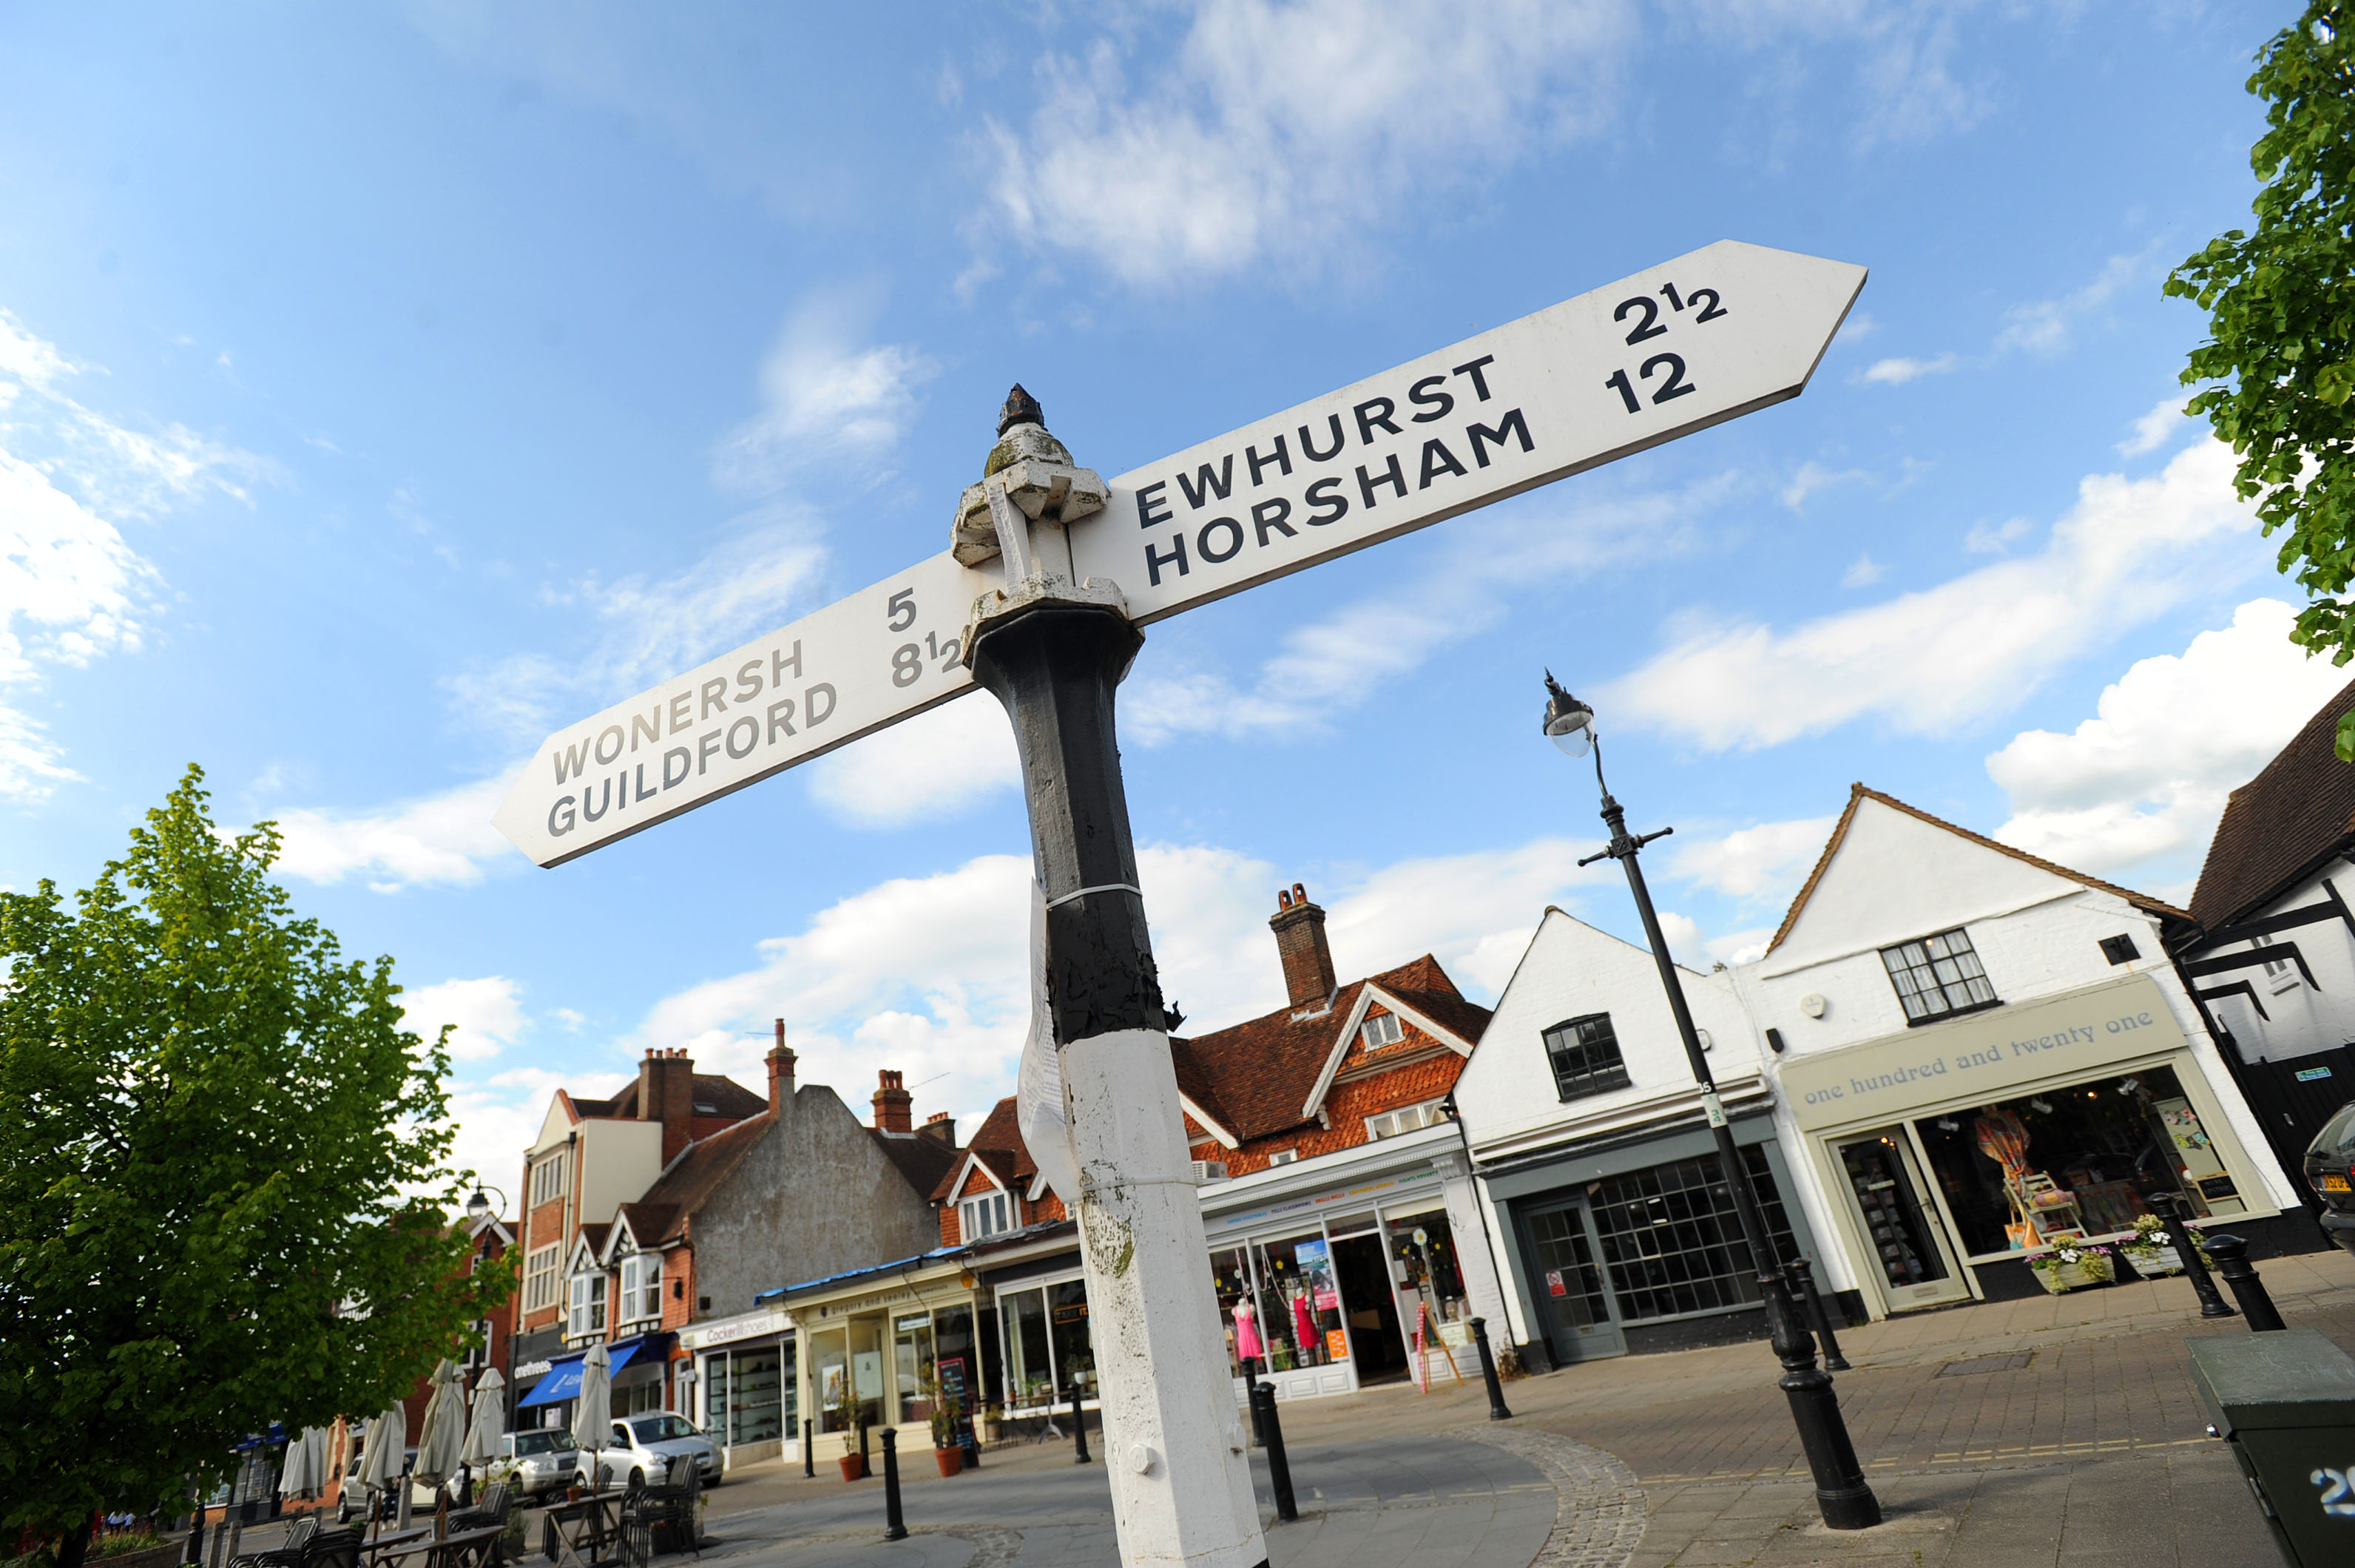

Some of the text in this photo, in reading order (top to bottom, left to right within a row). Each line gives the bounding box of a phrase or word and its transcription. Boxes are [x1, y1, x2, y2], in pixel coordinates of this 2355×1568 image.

[1136, 354, 1494, 529] EWHURST
[1145, 353, 1696, 587] HORSHAM 12
[547, 683, 837, 837] GUILDFORD
[553, 587, 916, 785] WONERSH 5
[1805, 1012, 2154, 1104] one hundred and twenty one
[864, 1296, 881, 1308] and
